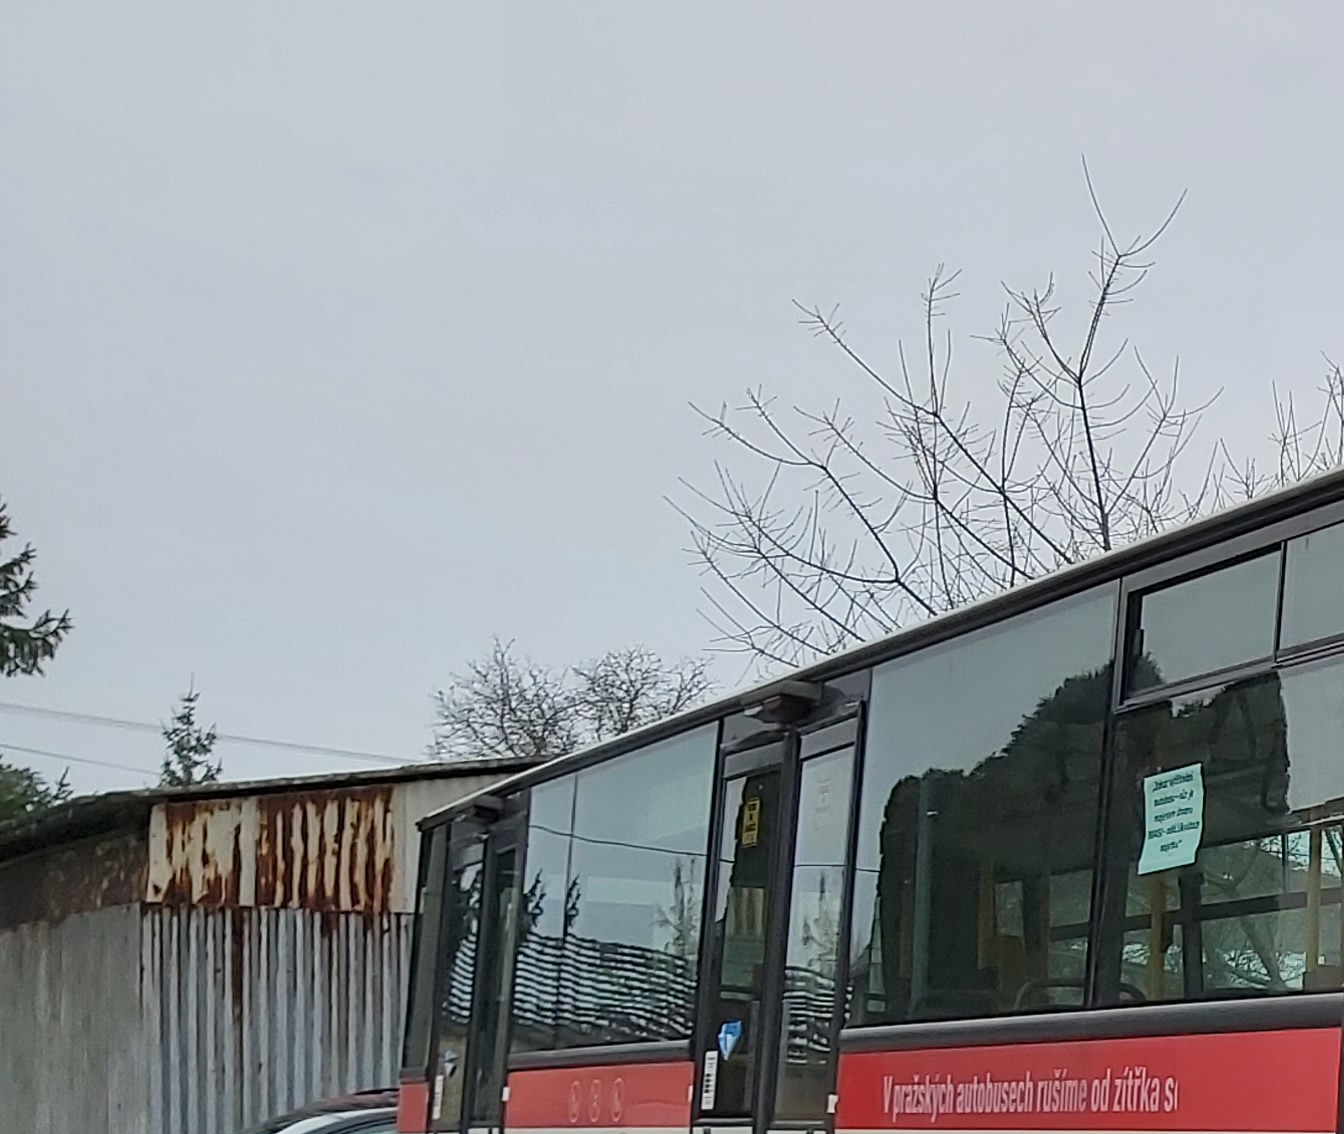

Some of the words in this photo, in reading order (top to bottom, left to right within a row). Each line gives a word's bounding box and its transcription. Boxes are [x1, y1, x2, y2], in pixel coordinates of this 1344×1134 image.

[883, 1075, 893, 1114] V
[892, 1072, 955, 1124] pražských
[955, 1070, 1034, 1114] autobusech
[1036, 1067, 1087, 1113] rušíme
[1090, 1067, 1112, 1113] od
[1112, 1065, 1160, 1113] zítřka
